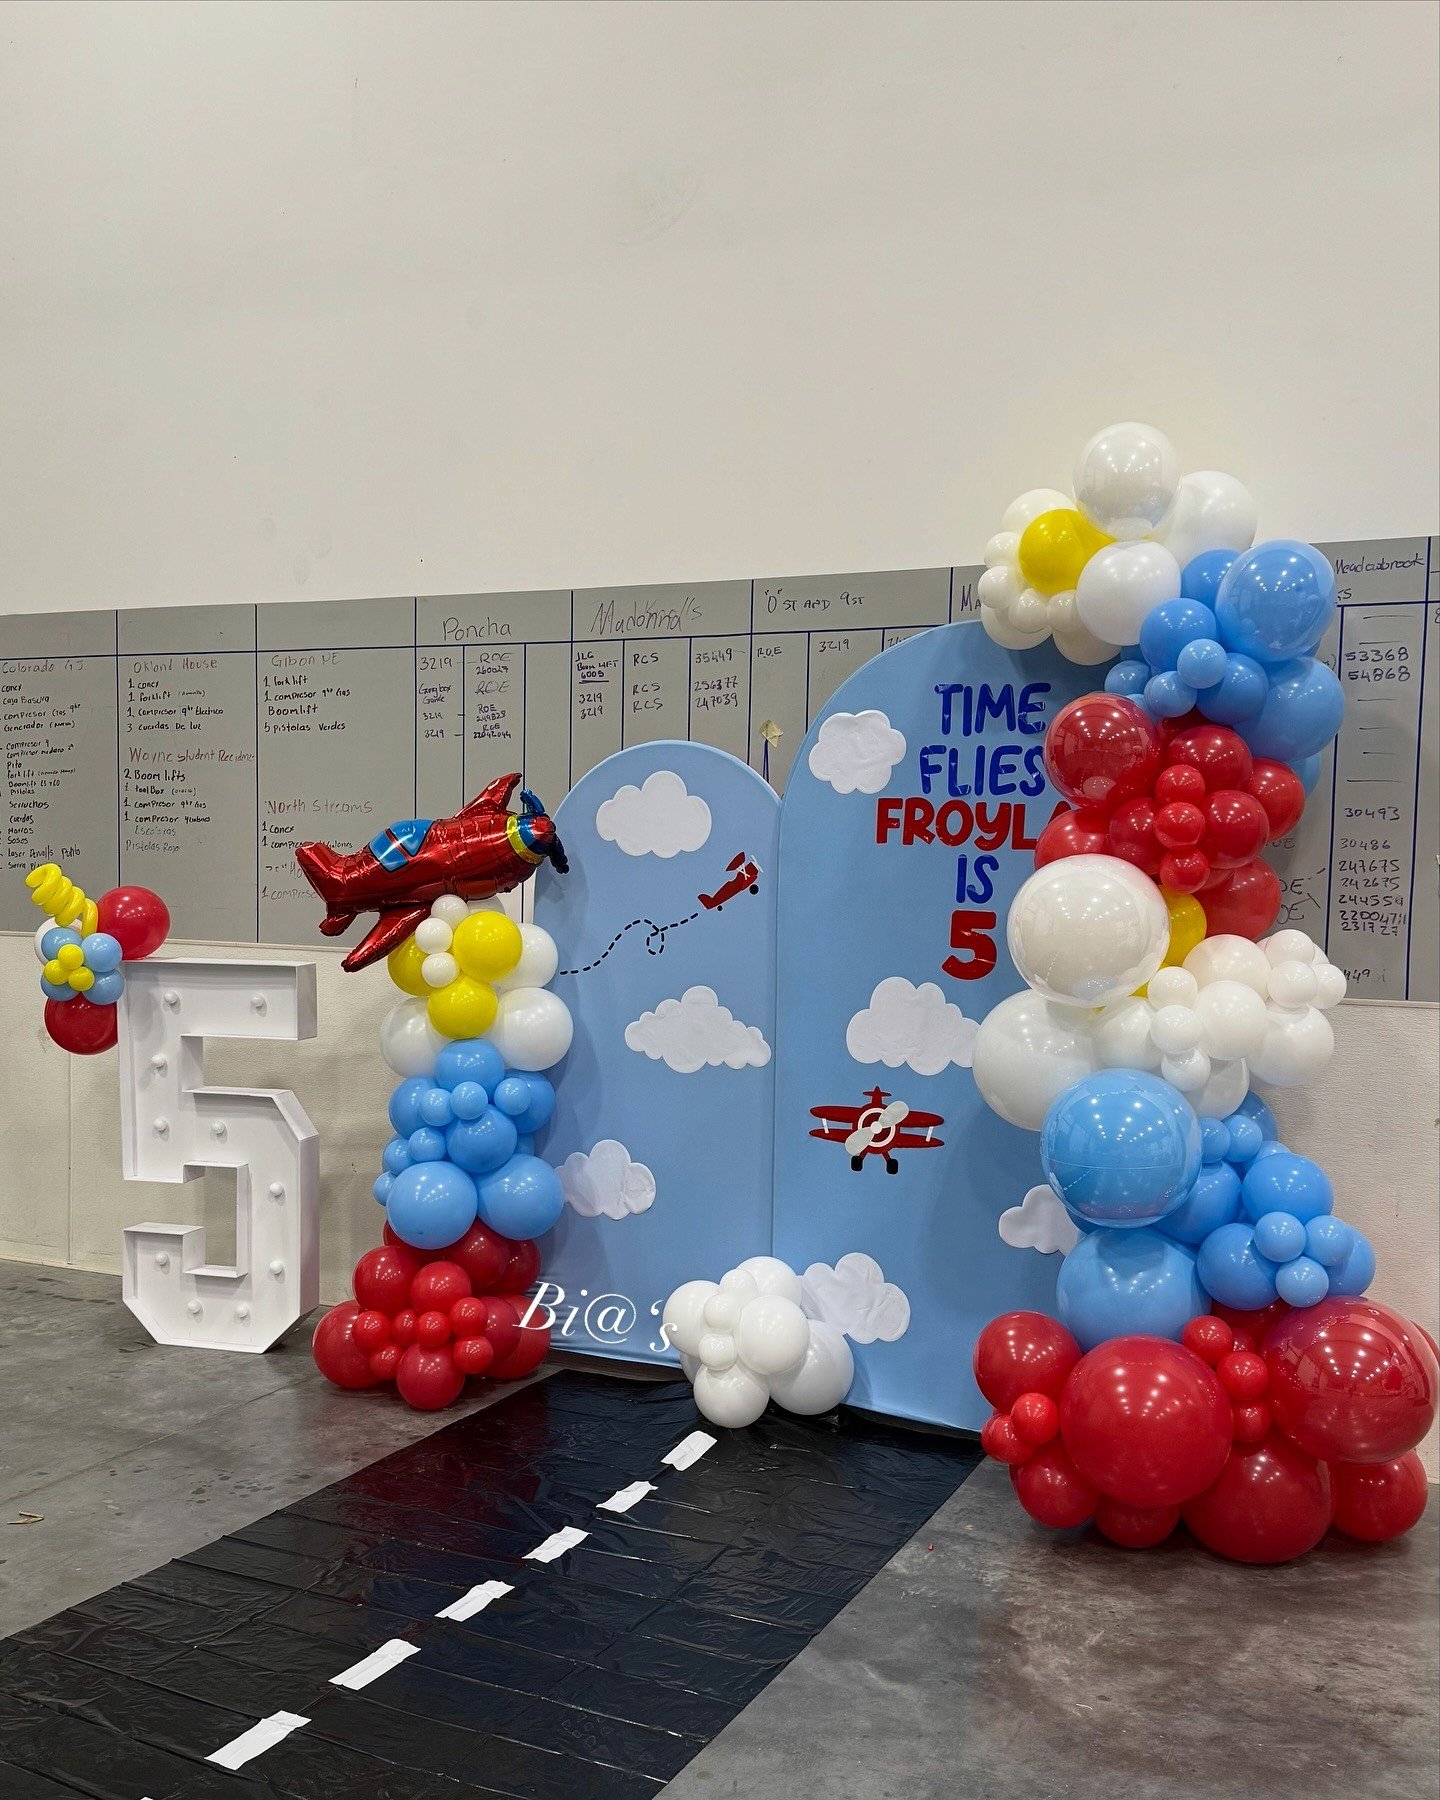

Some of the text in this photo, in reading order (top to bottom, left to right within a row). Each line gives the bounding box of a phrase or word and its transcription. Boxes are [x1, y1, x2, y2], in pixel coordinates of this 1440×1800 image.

[442, 616, 512, 641] Poncha
[818, 638, 851, 653] 3219
[1344, 646, 1410, 663] 53368
[419, 656, 453, 671] 3219
[1348, 665, 1411, 682] 54868
[934, 683, 1052, 737] TIME
[919, 745, 1047, 797] FLIES
[1344, 806, 1401, 821] 30493
[1340, 837, 1391, 851] 30486
[1338, 859, 1401, 875] 247675
[955, 854, 1000, 904] IS
[941, 910, 998, 982] 5
